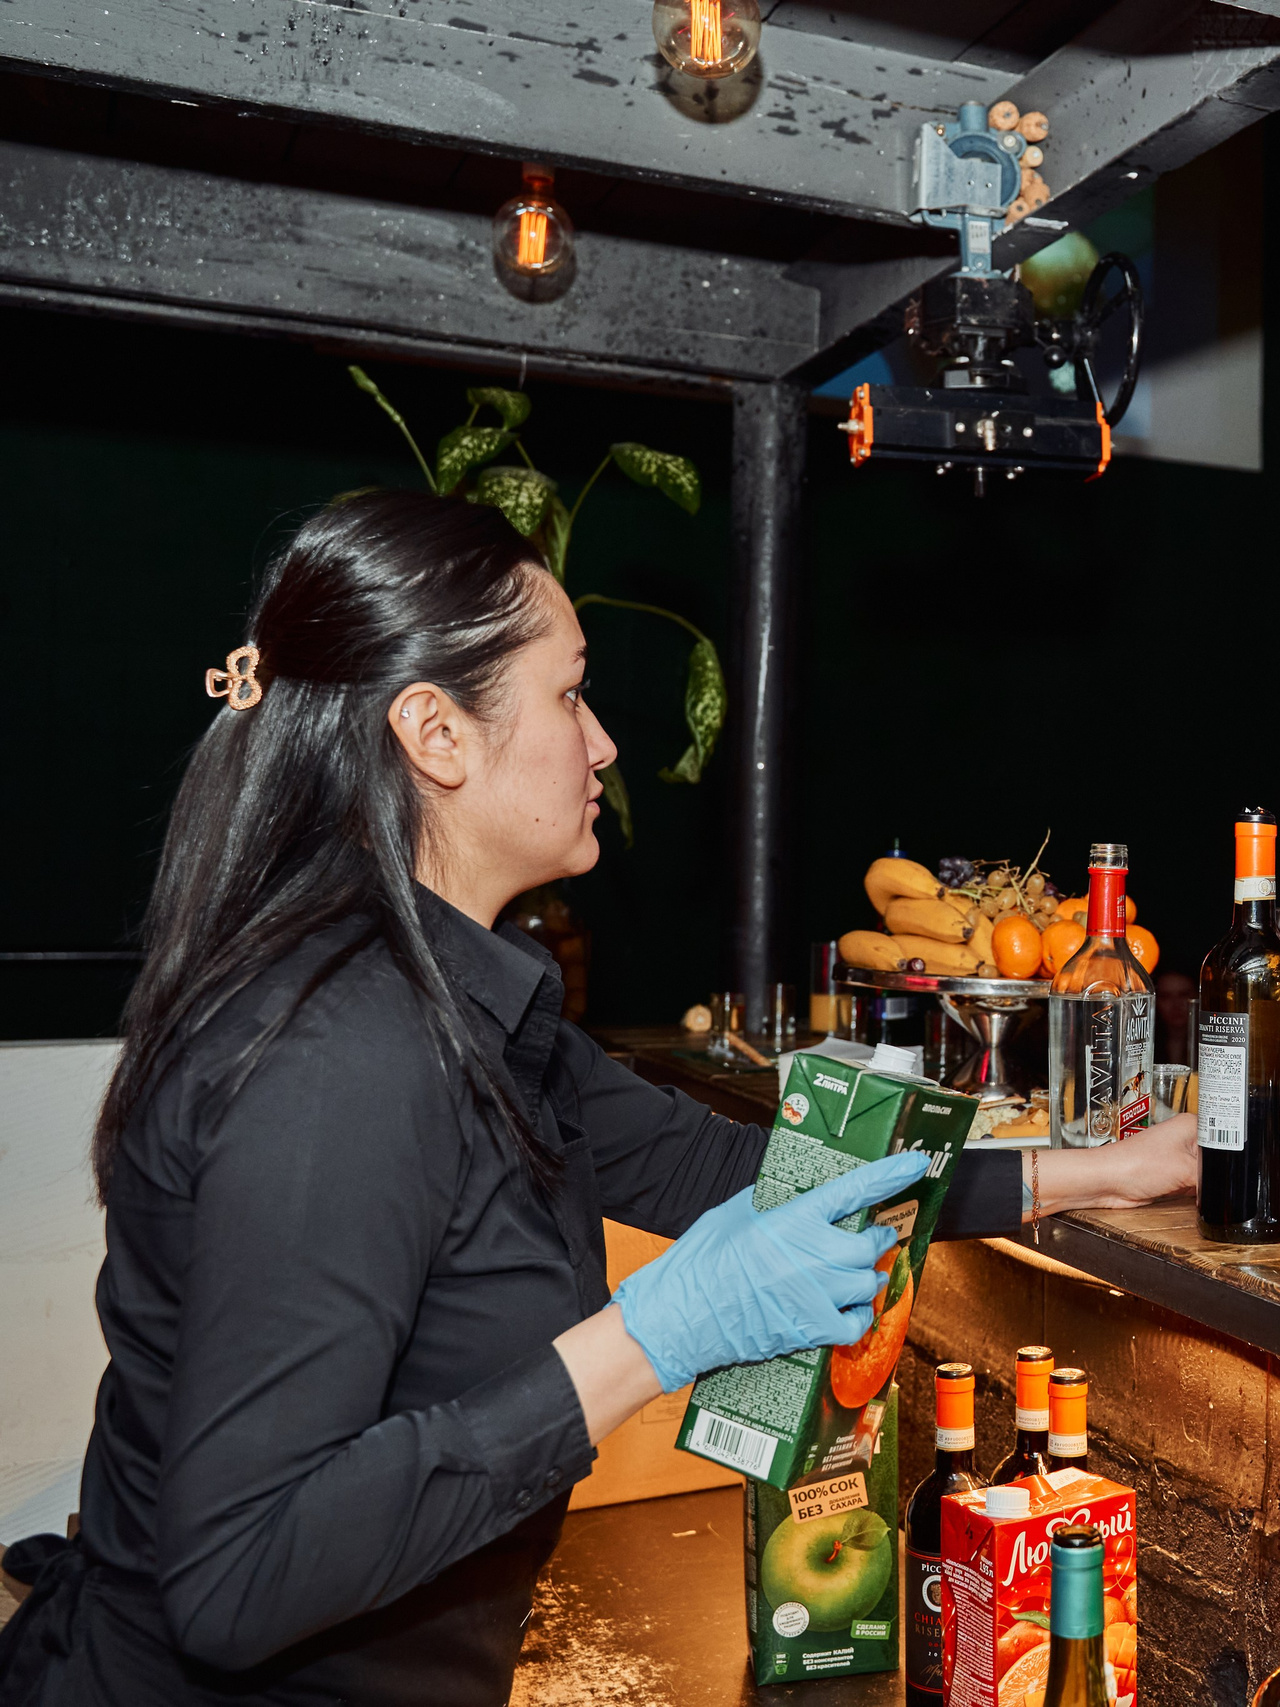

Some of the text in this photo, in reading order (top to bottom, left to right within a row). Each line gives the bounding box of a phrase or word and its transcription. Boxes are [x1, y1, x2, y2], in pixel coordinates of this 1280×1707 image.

[1126, 1017, 1150, 1041] AGAVITA
[1215, 1026, 1245, 1034] RISERVA
[821, 1080, 848, 1096] ЛИТРА
[1122, 1102, 1146, 1123] TEQUILA
[704, 1443, 730, 1459] 607042
[732, 1455, 758, 1471] 438776
[792, 1478, 859, 1504] 100% СОК
[830, 1497, 863, 1511] САХАРА
[798, 1504, 824, 1520] БЕЗ
[915, 1623, 940, 1638] RISE
[803, 1647, 854, 1659] Содержит КАЛИЙ
[814, 1655, 853, 1663] консервантов
[818, 1661, 850, 1669] красителей
